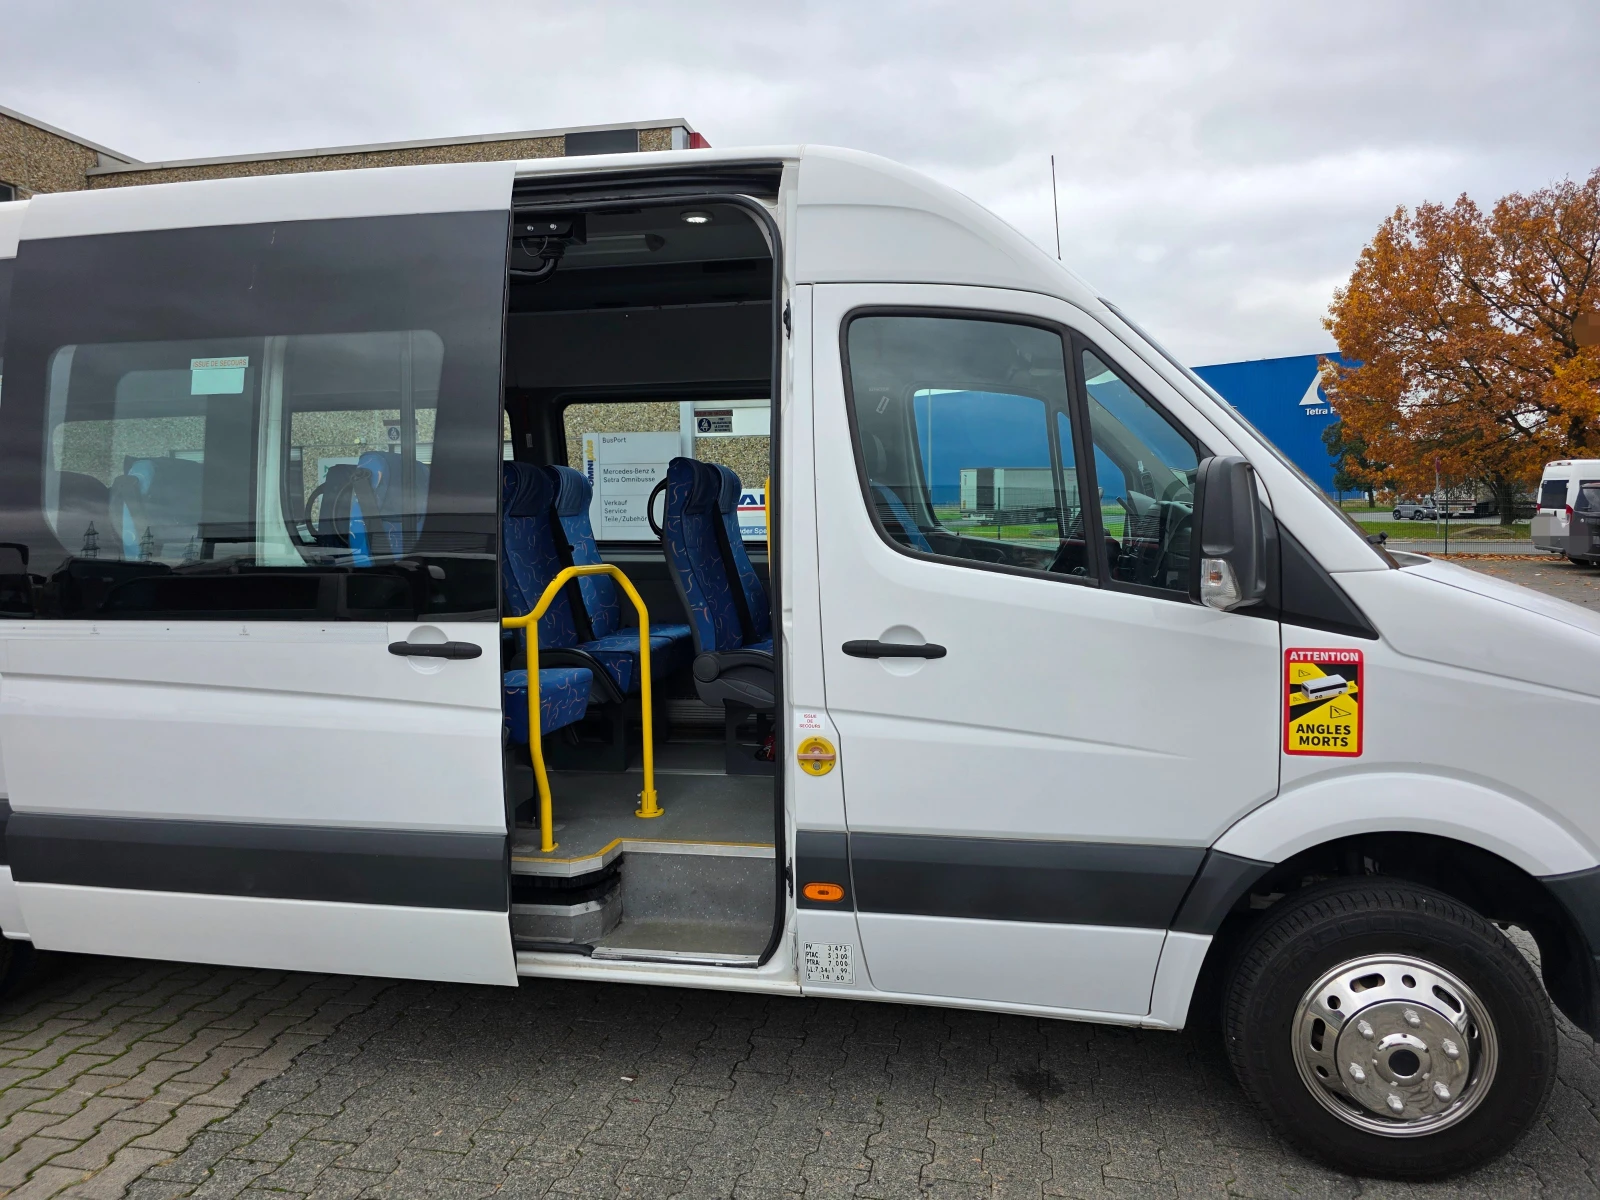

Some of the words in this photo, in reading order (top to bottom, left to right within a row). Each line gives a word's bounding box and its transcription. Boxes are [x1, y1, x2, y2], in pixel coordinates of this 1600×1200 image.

[1290, 651, 1358, 661] ATTENTION
[1296, 724, 1351, 735] ANGLES
[1299, 735, 1348, 747] MORTS
